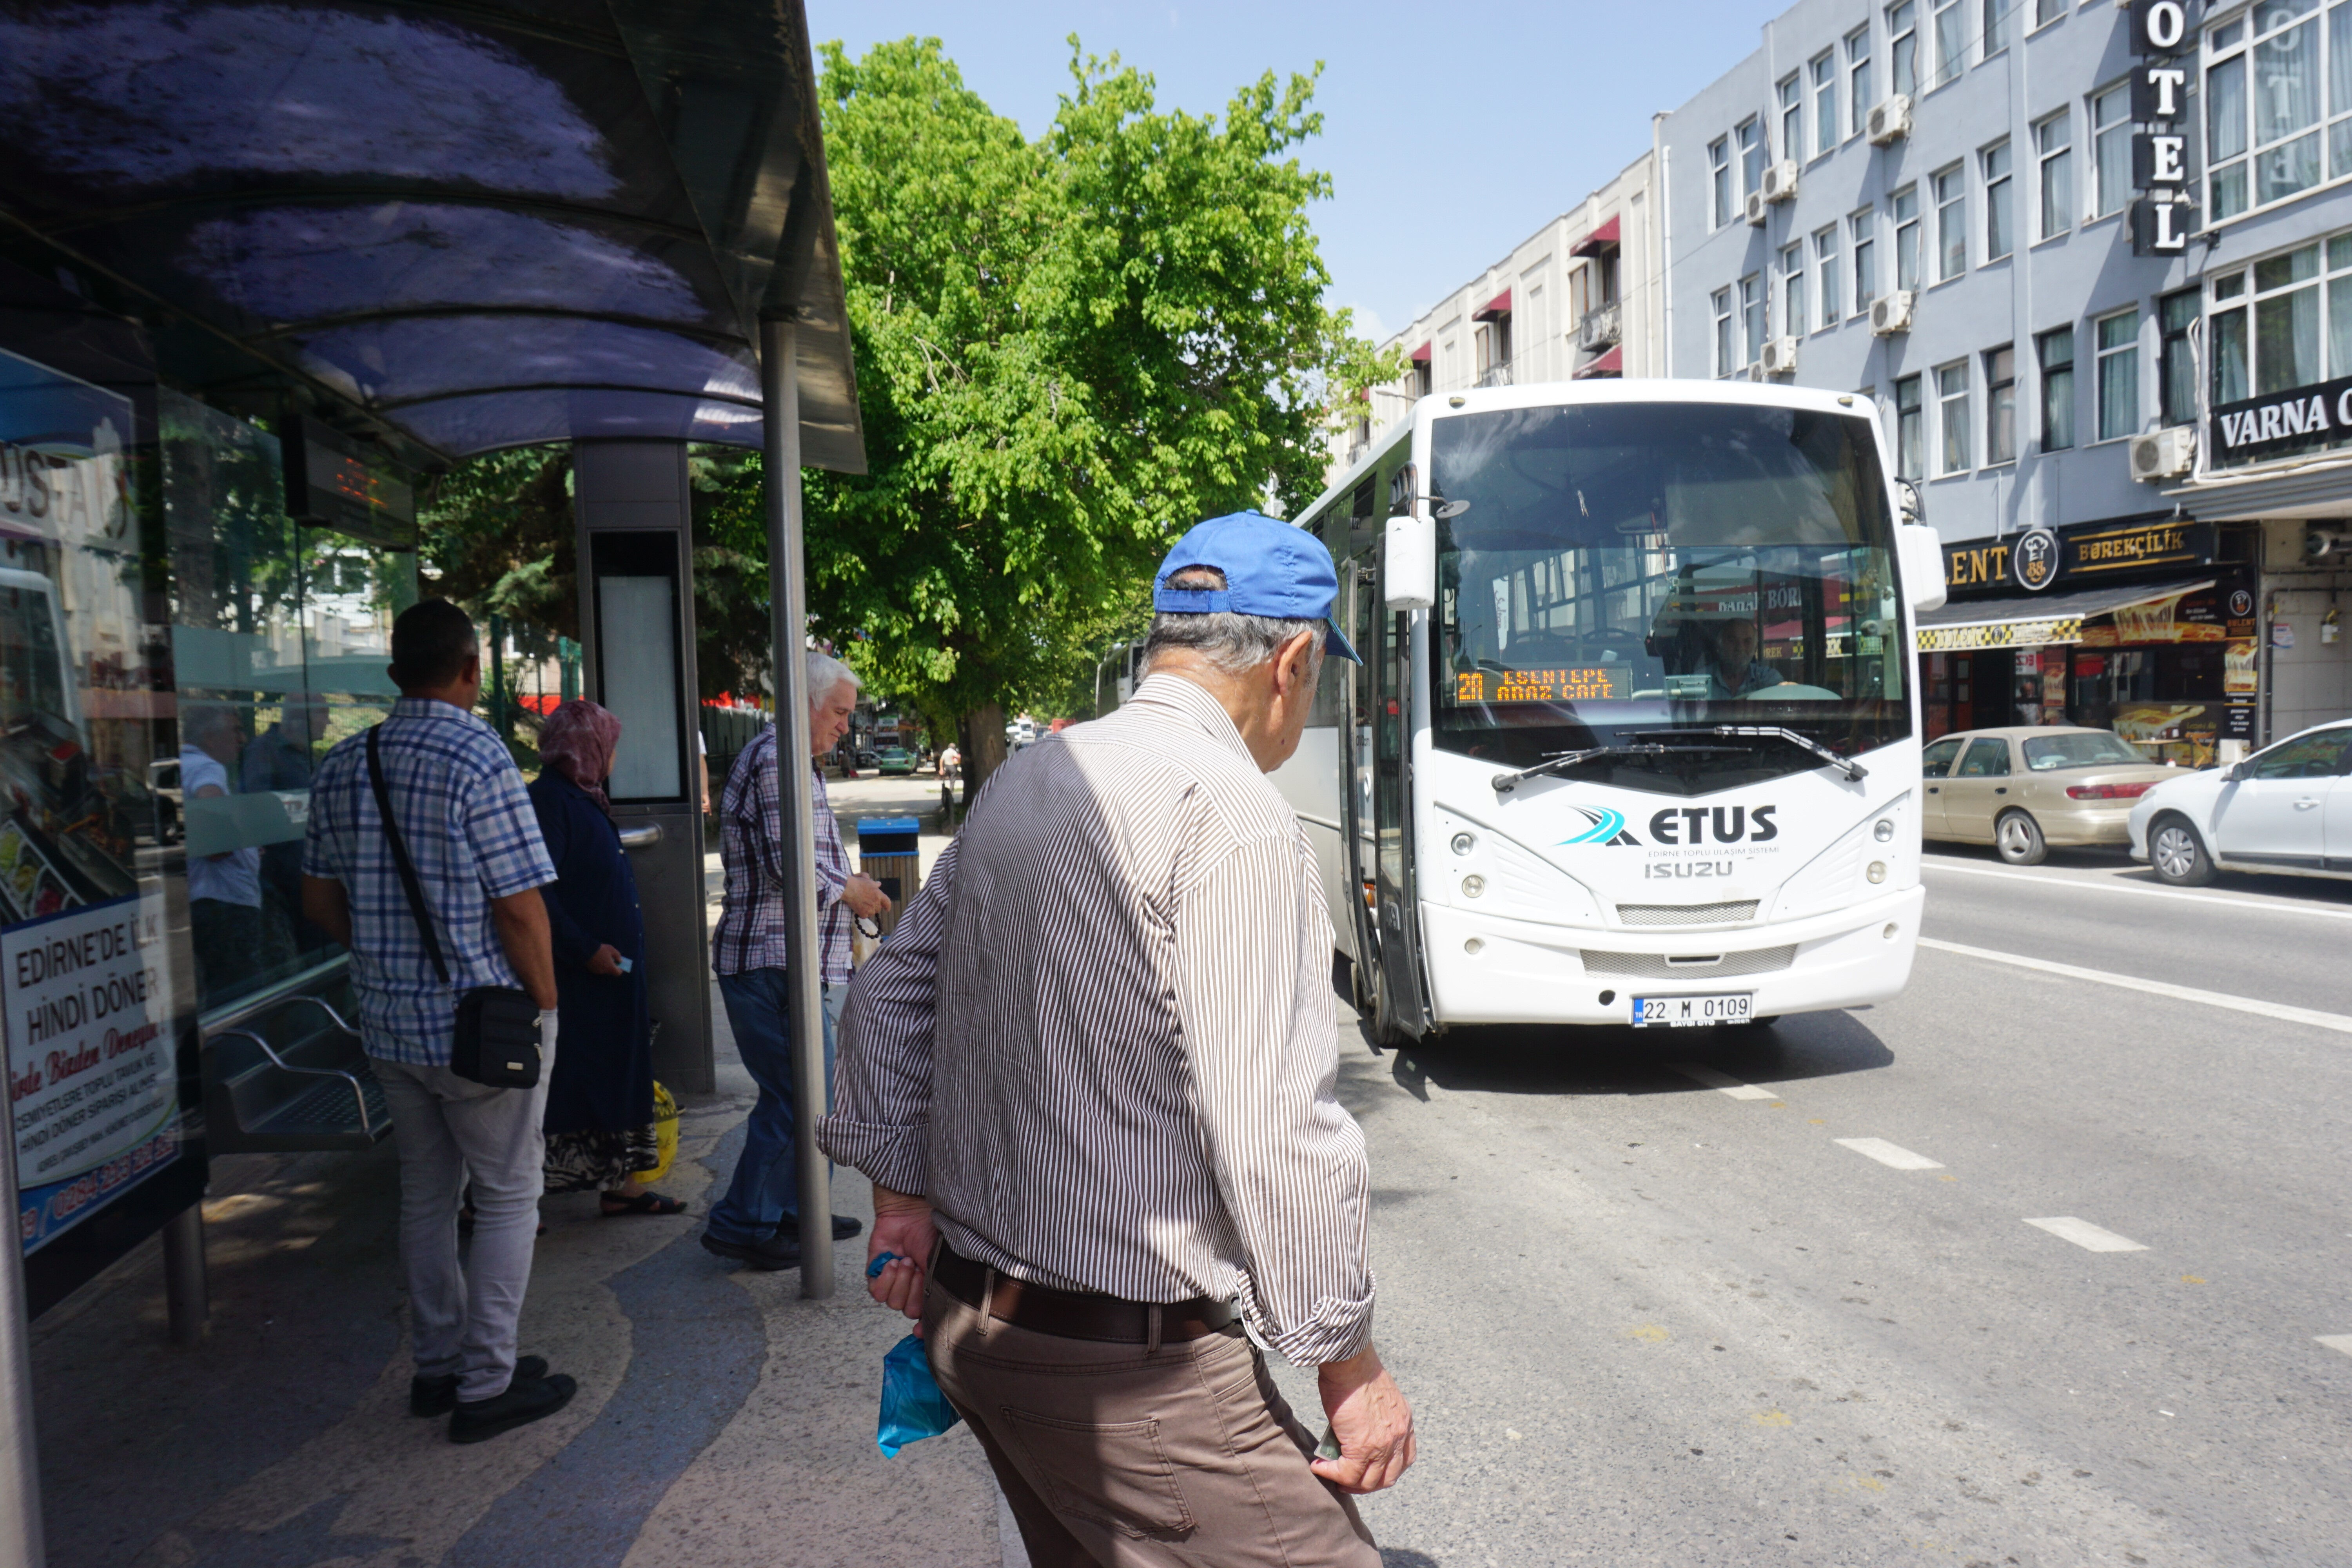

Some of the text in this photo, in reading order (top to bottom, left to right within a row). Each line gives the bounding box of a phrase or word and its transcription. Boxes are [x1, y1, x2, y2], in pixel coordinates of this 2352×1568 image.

[2147, 1, 2185, 249] OTEL
[2220, 395, 2330, 448] VARNA
[1946, 546, 2008, 586] ENT
[1459, 668, 1608, 701] 2A ESENTEPE
[1563, 684, 1613, 699] CAFE
[1649, 805, 1778, 845] ETUS
[1645, 861, 1733, 879] ISUZU
[1714, 848, 1746, 856] ULAŞIM
[16, 924, 127, 989] EDİRNE'DE
[27, 967, 159, 1045] HİNDİ DÖNER
[1644, 998, 1748, 1019] 22 M 0109
[54, 1172, 98, 1220] 0284
